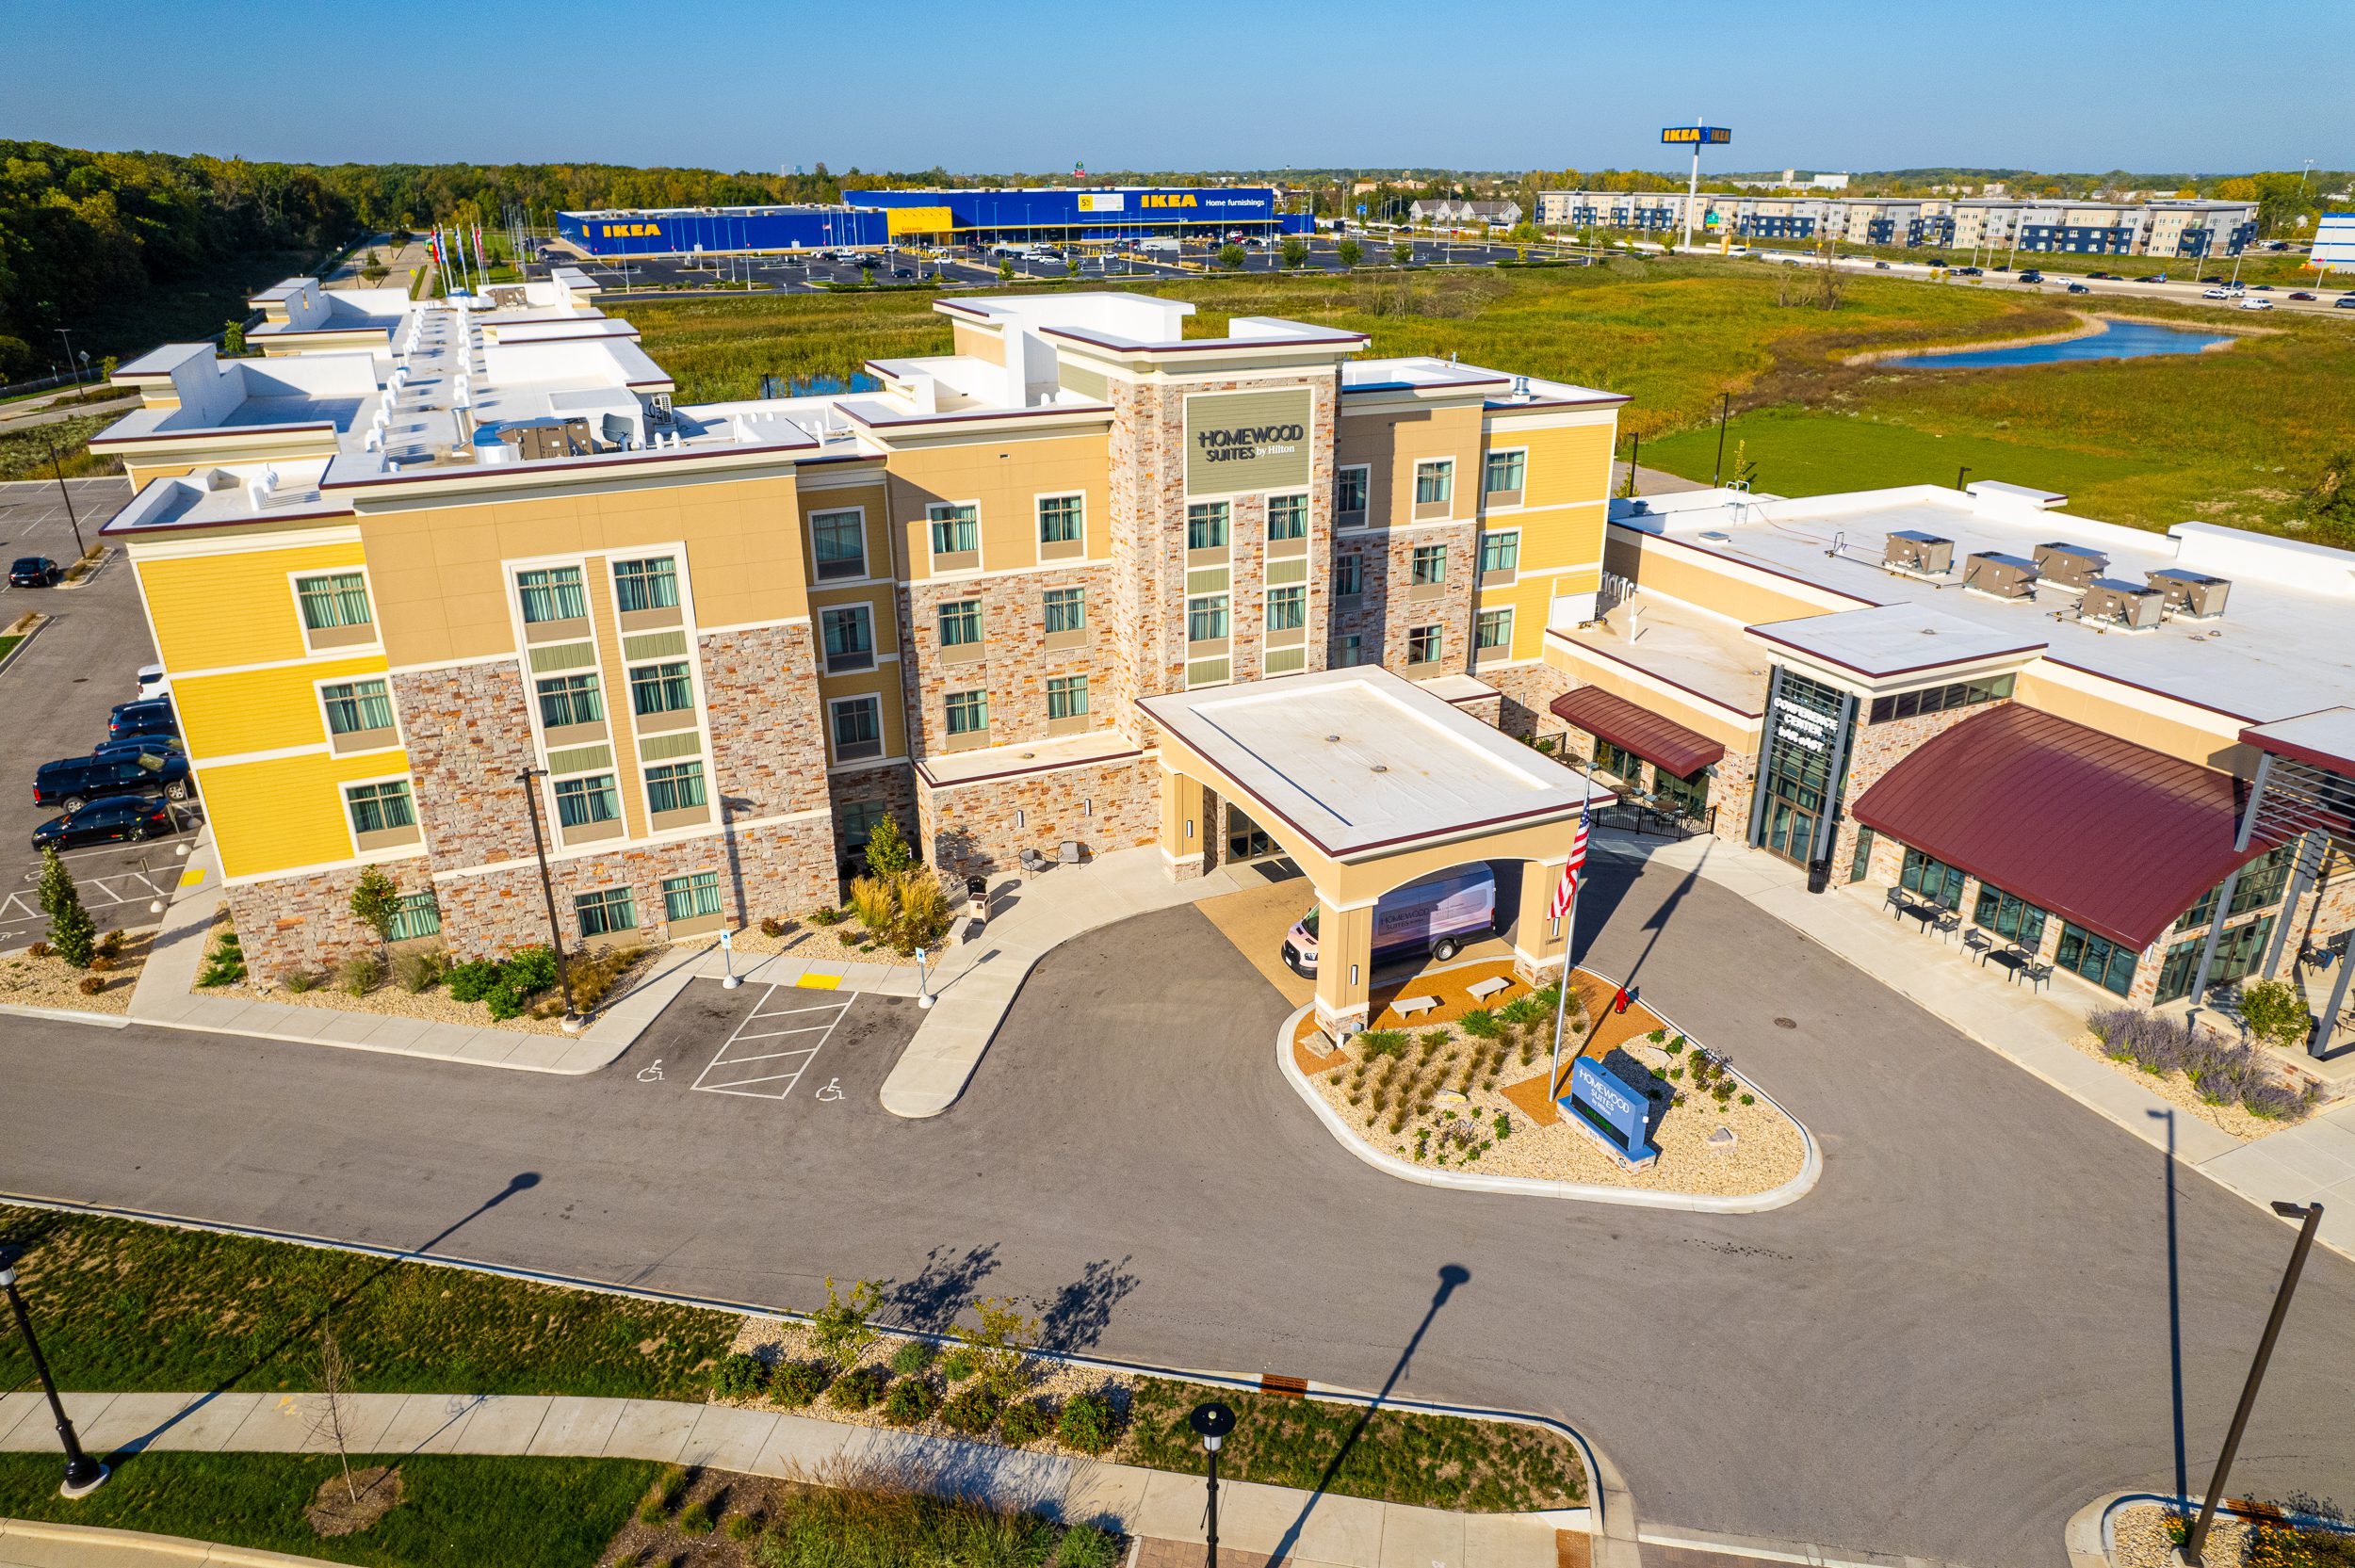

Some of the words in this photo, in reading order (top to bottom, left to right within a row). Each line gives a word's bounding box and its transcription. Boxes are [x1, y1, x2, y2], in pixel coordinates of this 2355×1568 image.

[1663, 128, 1700, 142] IKEA
[1711, 129, 1730, 142] IKEA
[1141, 194, 1197, 208] IKEA
[1227, 198, 1265, 207] furnishings
[602, 223, 661, 237] IKEA
[1197, 424, 1304, 448] HOMEWOOD
[1206, 446, 1256, 462] SUITES
[1256, 446, 1267, 458] by
[1268, 445, 1295, 455] Hilton
[1774, 697, 1839, 731] CONFERENCE
[1783, 713, 1824, 736] CENTER
[1380, 908, 1430, 925] HOMEWOOD
[1387, 921, 1409, 929] SUITES
[1579, 1068, 1630, 1114] HOMEWOOD
[1591, 1088, 1615, 1112] SUITES
[1597, 1101, 1612, 1116] Hilton
